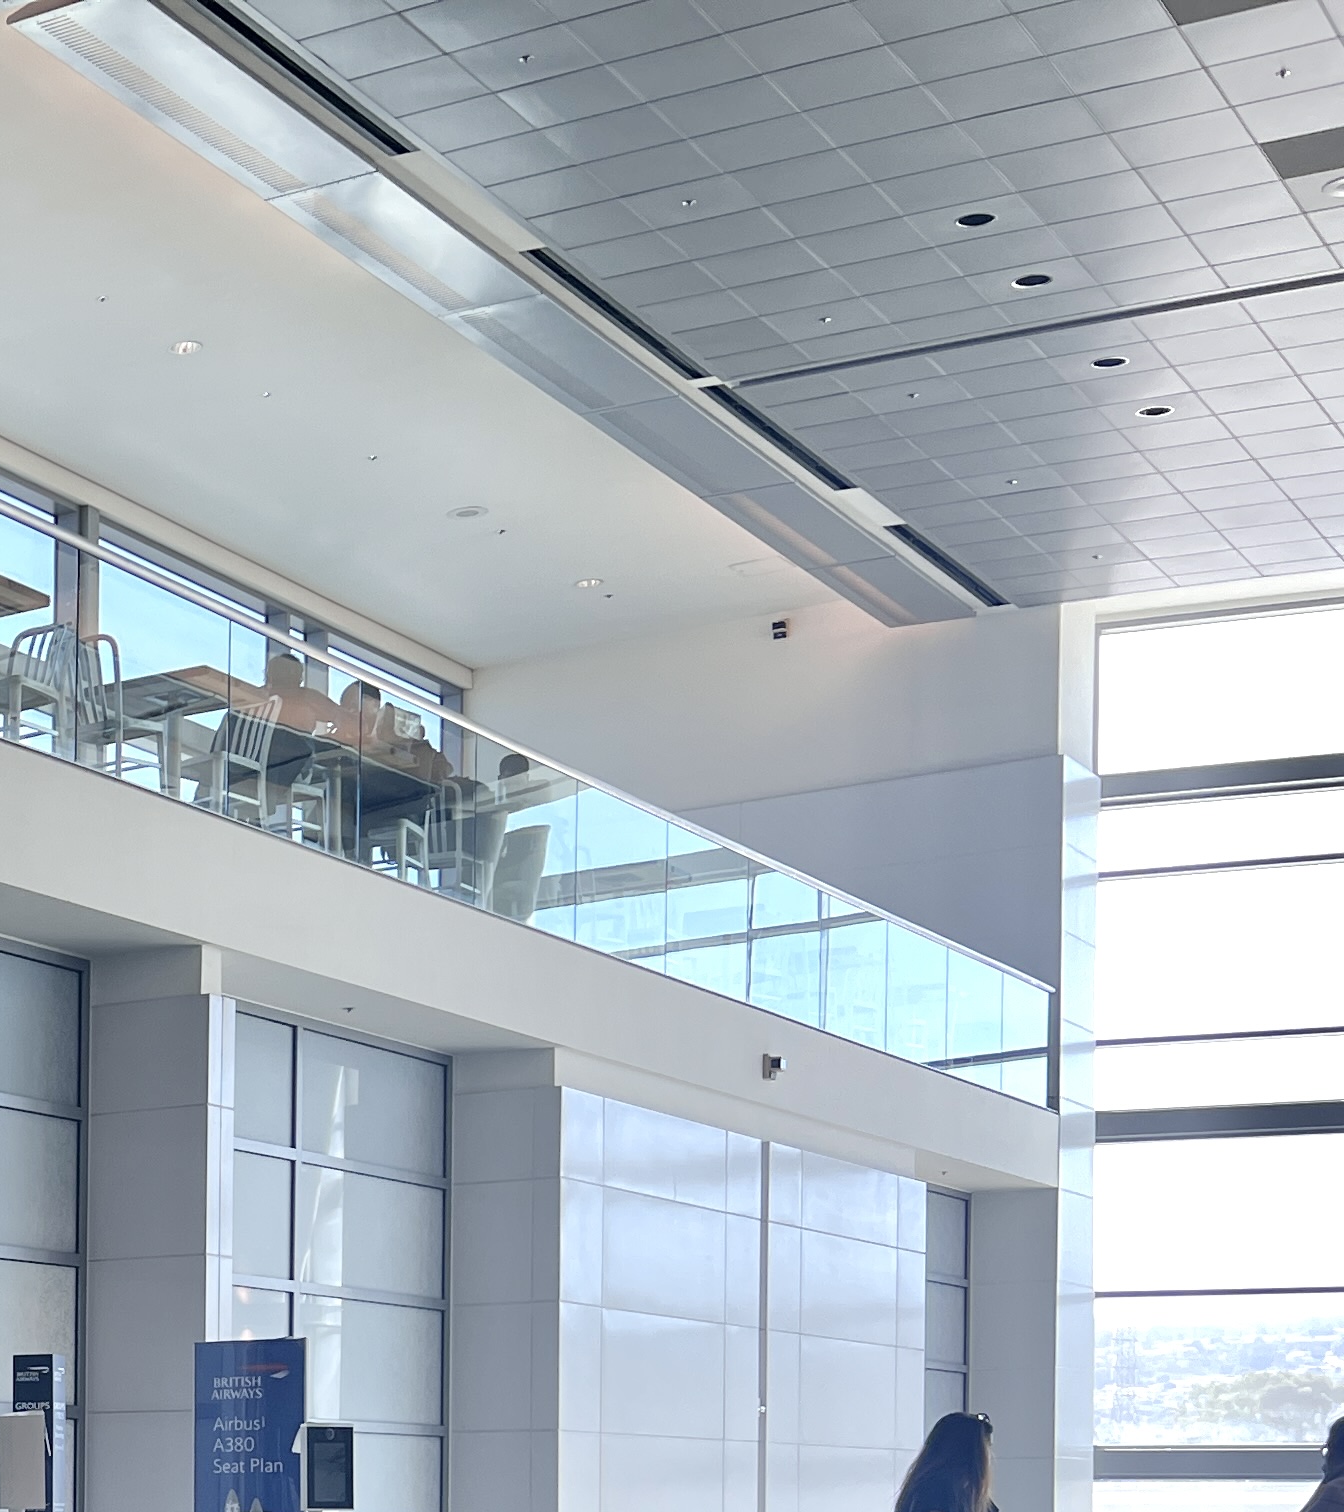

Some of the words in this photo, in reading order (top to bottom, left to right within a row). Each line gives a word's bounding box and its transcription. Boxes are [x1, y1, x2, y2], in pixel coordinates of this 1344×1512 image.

[214, 1376, 262, 1388] BRITISH
[212, 1387, 263, 1400] AIRWAYS
[213, 1416, 260, 1431] Airbus
[213, 1437, 255, 1452] A380
[213, 1458, 245, 1474] Seat
[250, 1458, 283, 1473] Plan
